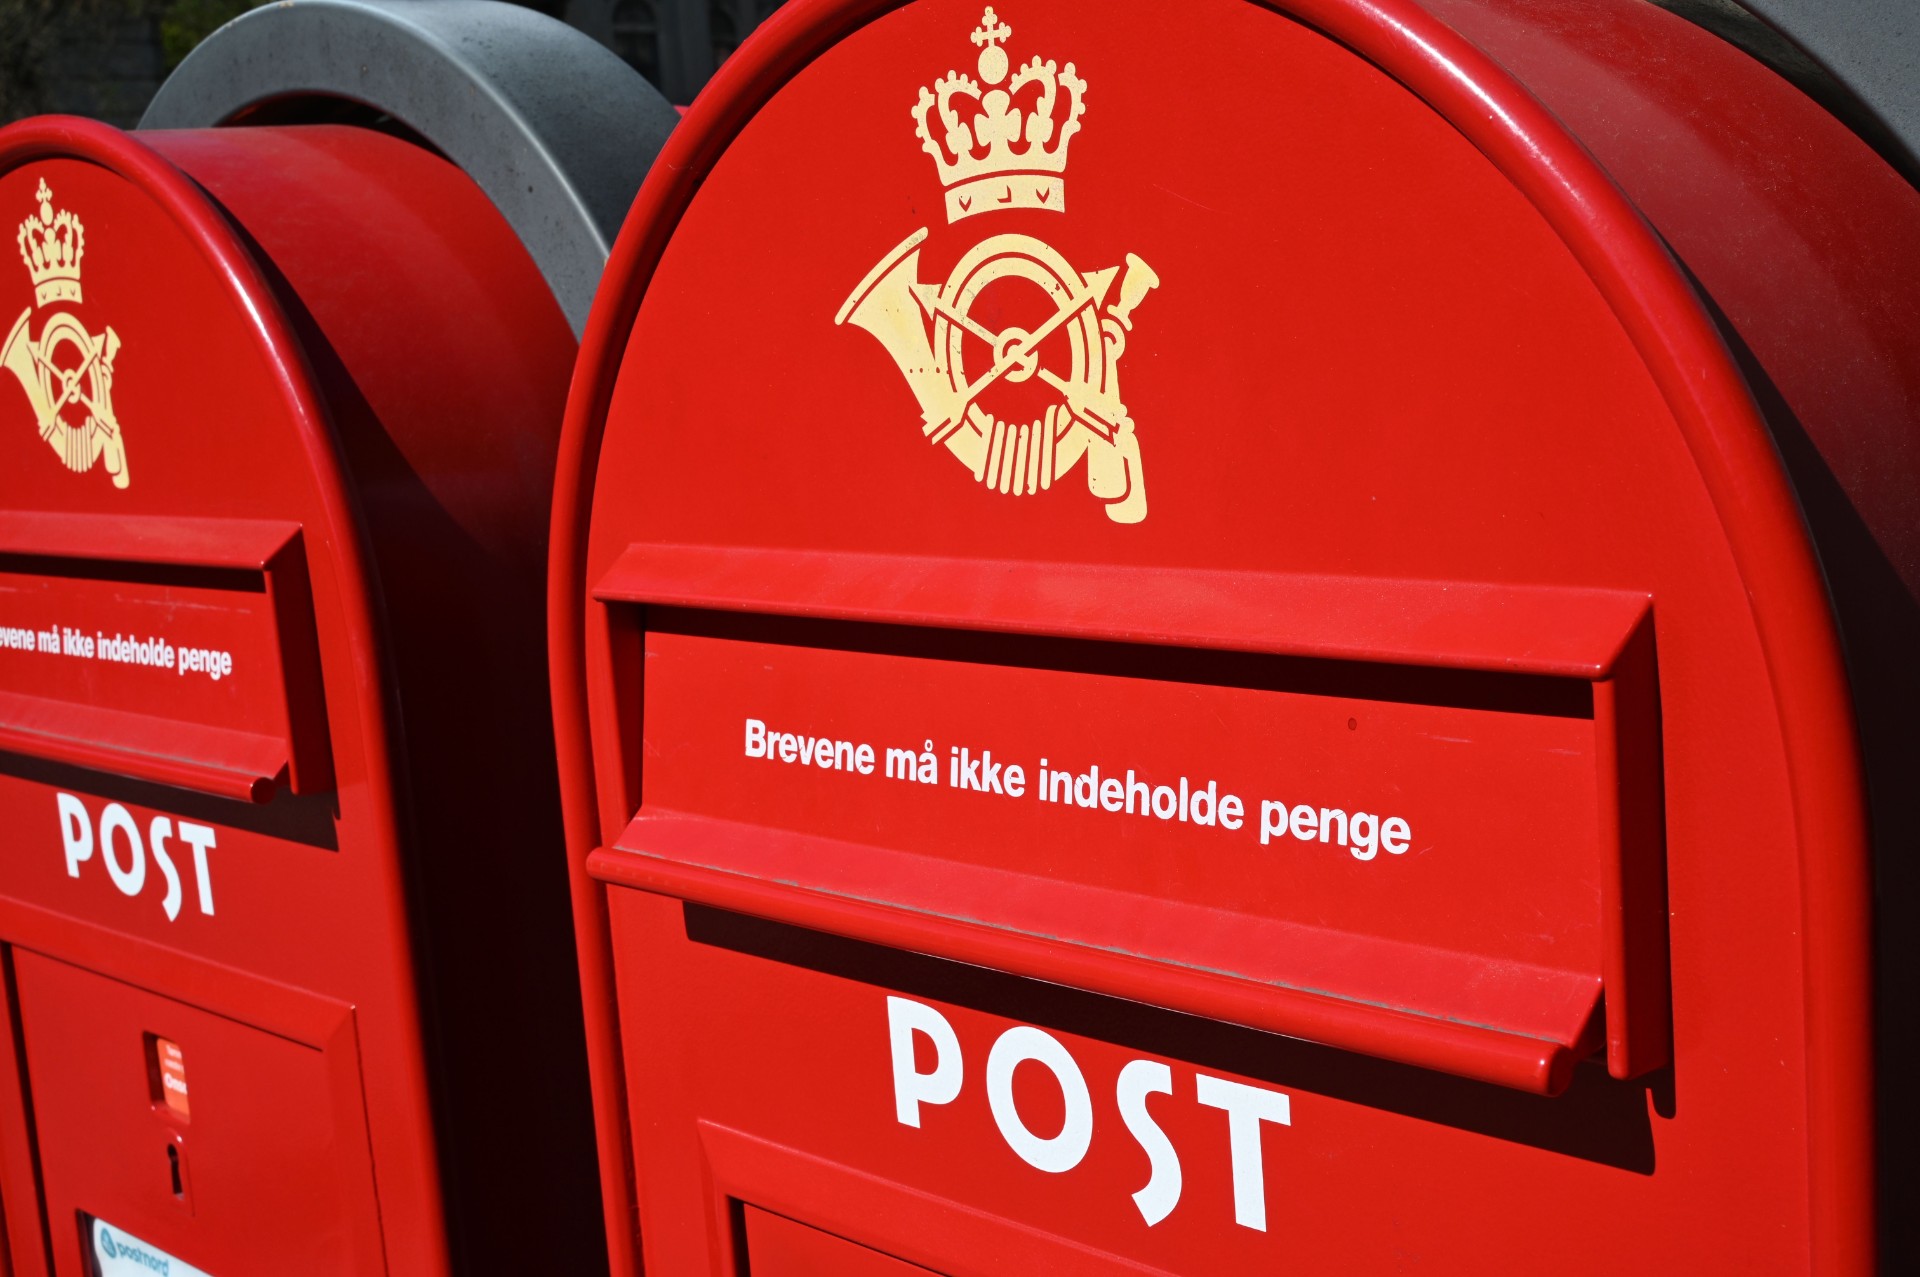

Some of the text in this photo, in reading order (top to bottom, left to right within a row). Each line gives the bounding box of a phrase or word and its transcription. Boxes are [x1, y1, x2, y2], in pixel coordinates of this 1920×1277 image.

[37, 624, 61, 654] må
[62, 627, 95, 659] ikke
[97, 631, 175, 669] indeholde
[178, 646, 233, 681] penge
[744, 718, 1412, 861] Brevene må ikke indeholde penge
[56, 792, 217, 922] POST
[886, 995, 1292, 1233] POST
[116, 1241, 170, 1277] postnord
